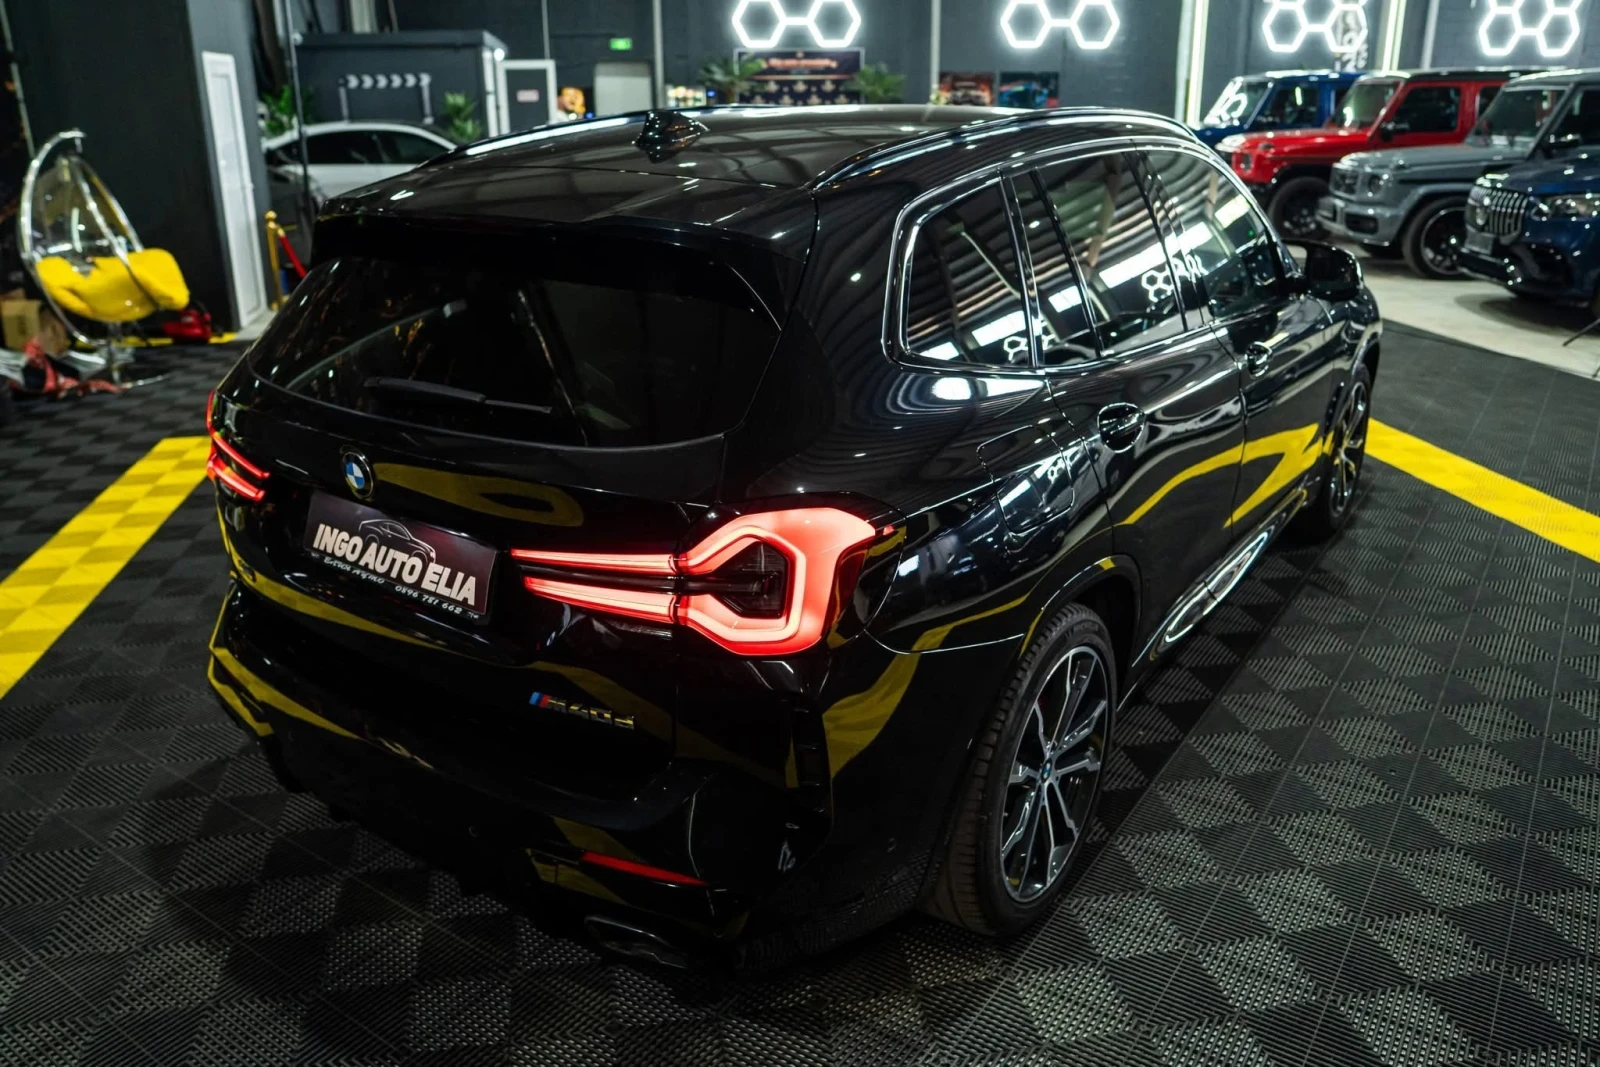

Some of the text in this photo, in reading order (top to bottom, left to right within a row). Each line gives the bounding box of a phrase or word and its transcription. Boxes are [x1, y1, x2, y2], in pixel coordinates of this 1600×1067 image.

[313, 523, 477, 606] INGO AUTO ELIA
[395, 585, 418, 598] 0896
[422, 594, 440, 605] 781
[441, 602, 462, 614] 662
